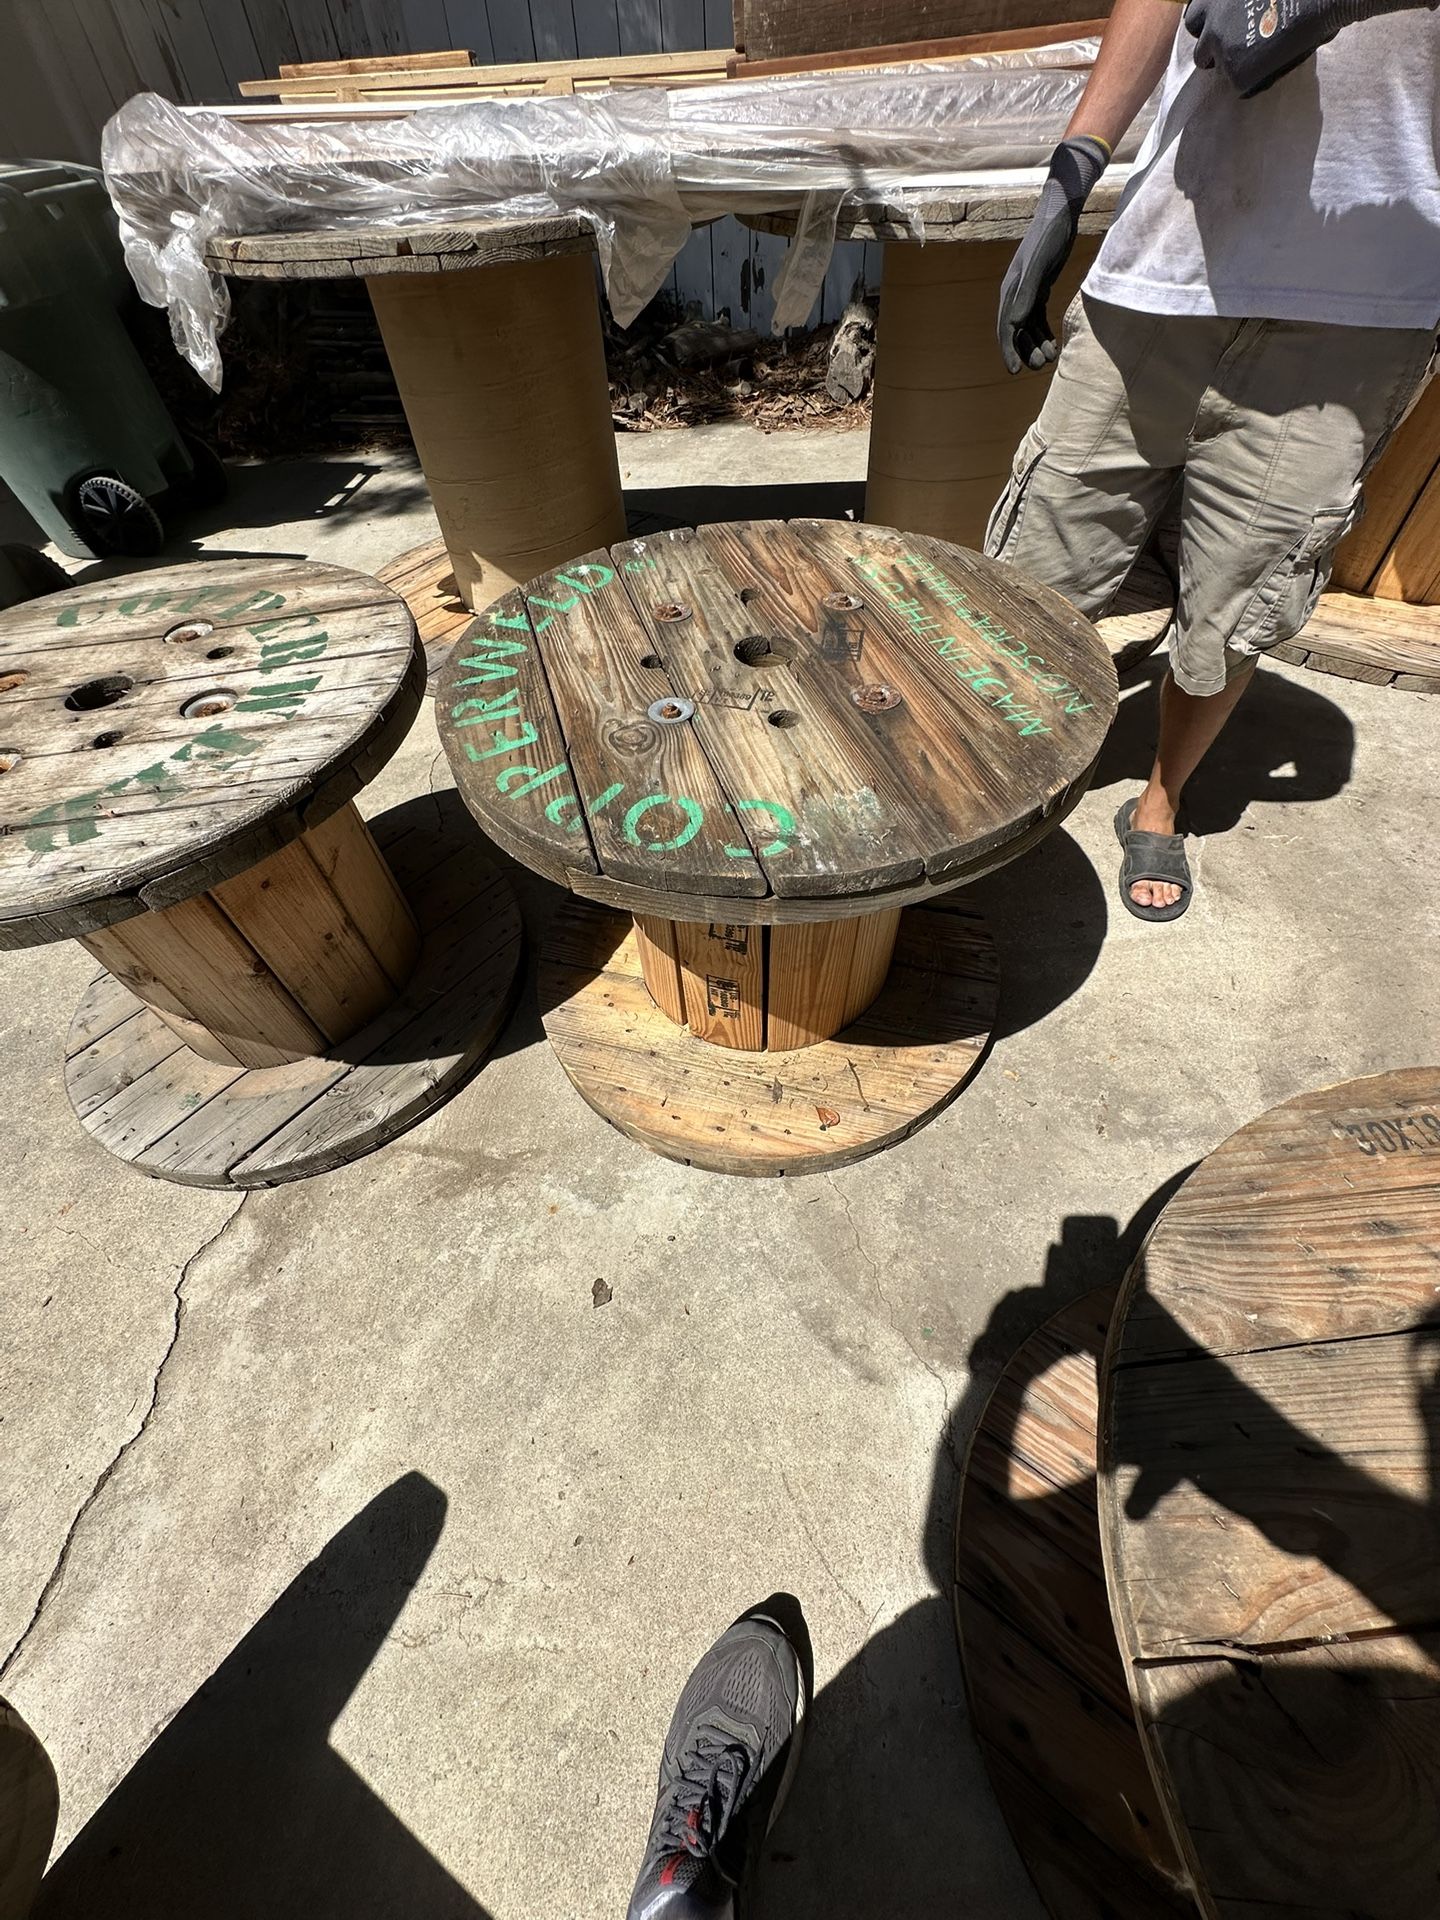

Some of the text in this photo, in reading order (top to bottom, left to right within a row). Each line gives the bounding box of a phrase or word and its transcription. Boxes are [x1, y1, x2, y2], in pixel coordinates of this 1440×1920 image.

[1245, 0, 1256, 47] Maxi
[888, 598, 940, 635] THE
[956, 606, 1045, 669] SCRAP
[929, 636, 972, 660] IN
[957, 663, 1052, 736] MADE
[1032, 673, 1094, 714] NO
